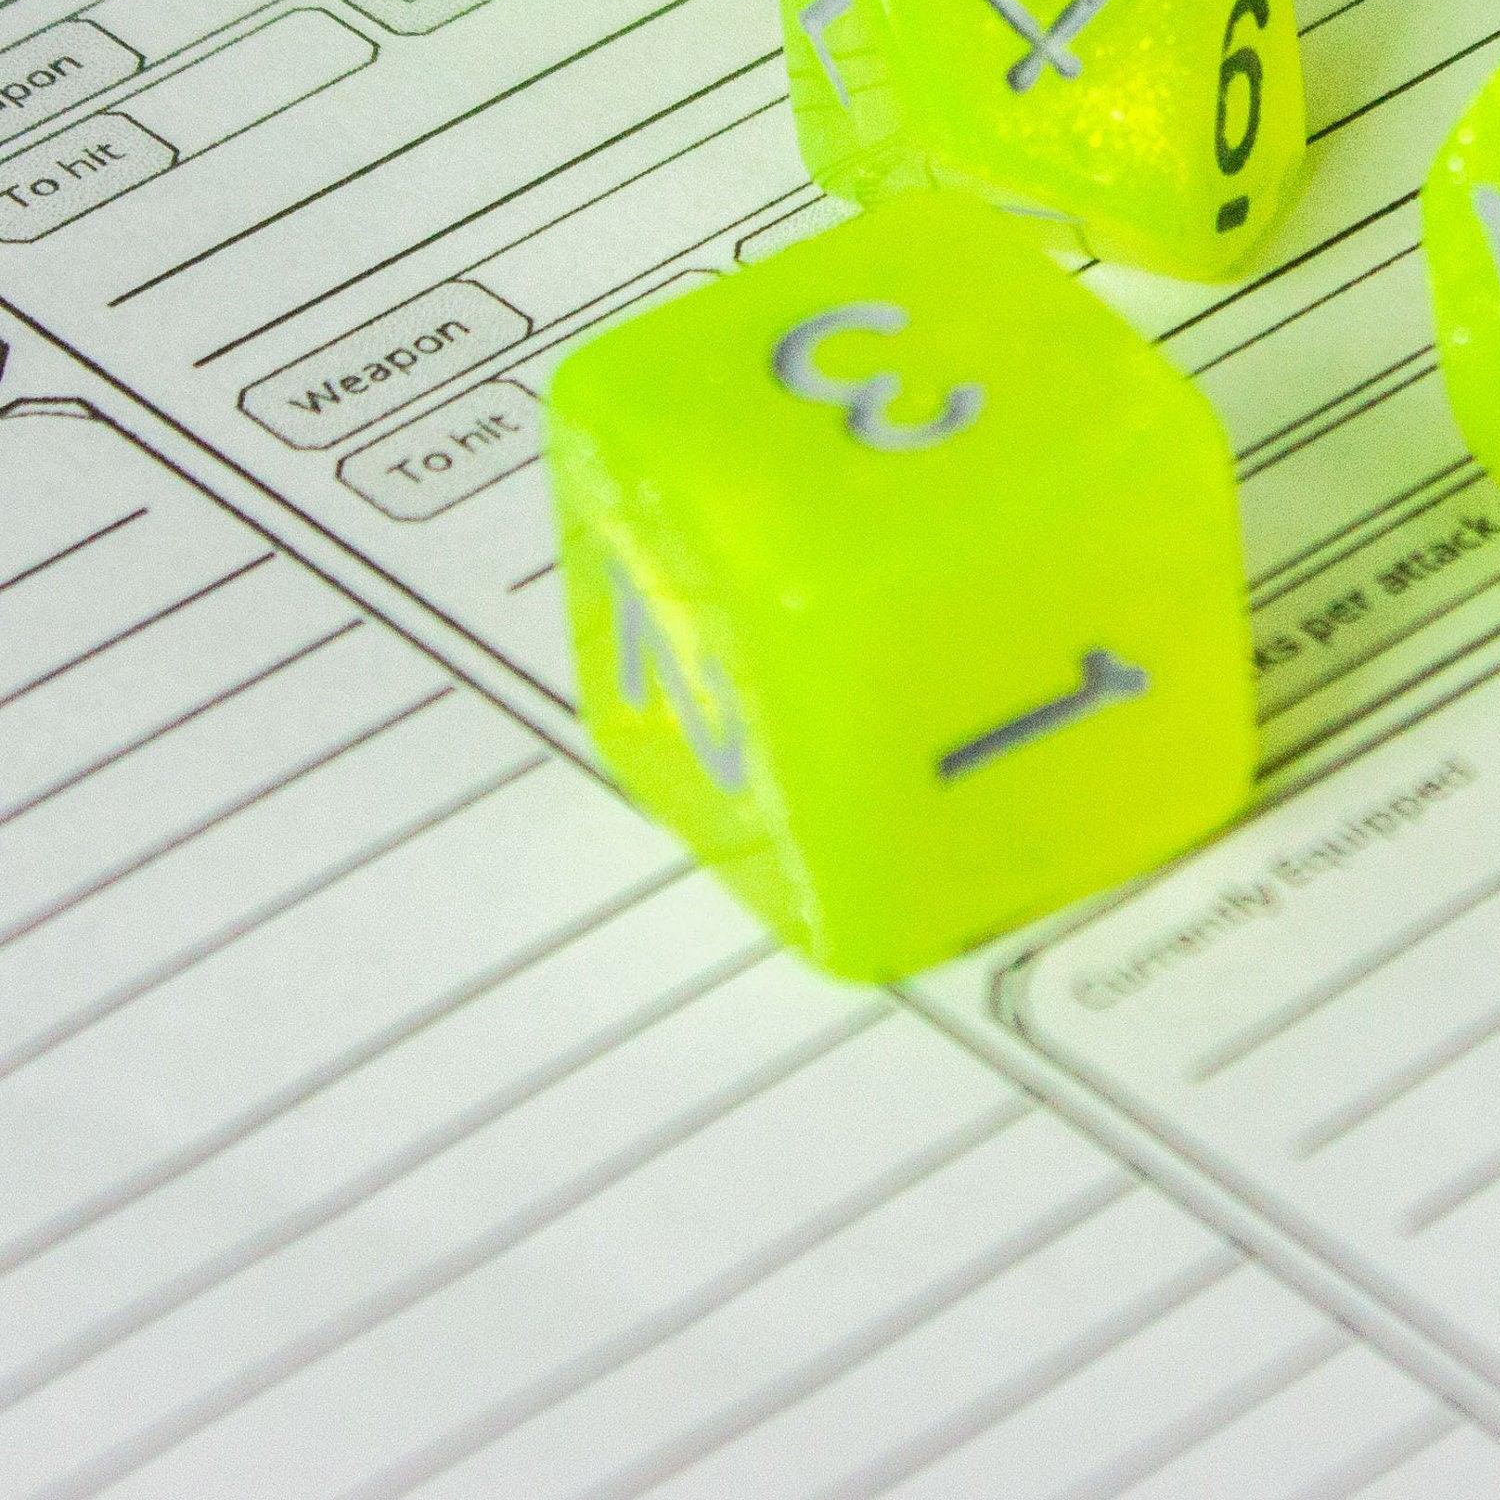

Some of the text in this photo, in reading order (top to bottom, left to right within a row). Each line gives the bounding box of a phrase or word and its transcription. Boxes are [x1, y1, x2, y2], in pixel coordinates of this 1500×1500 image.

[0, 55, 84, 111] pon
[0, 143, 126, 208] To hit
[288, 315, 472, 417] Weapon
[770, 302, 985, 452] 3
[387, 411, 521, 487] To hit
[1301, 587, 1374, 645] per
[935, 646, 1149, 787] 1
[1272, 754, 1478, 889] Equipped
